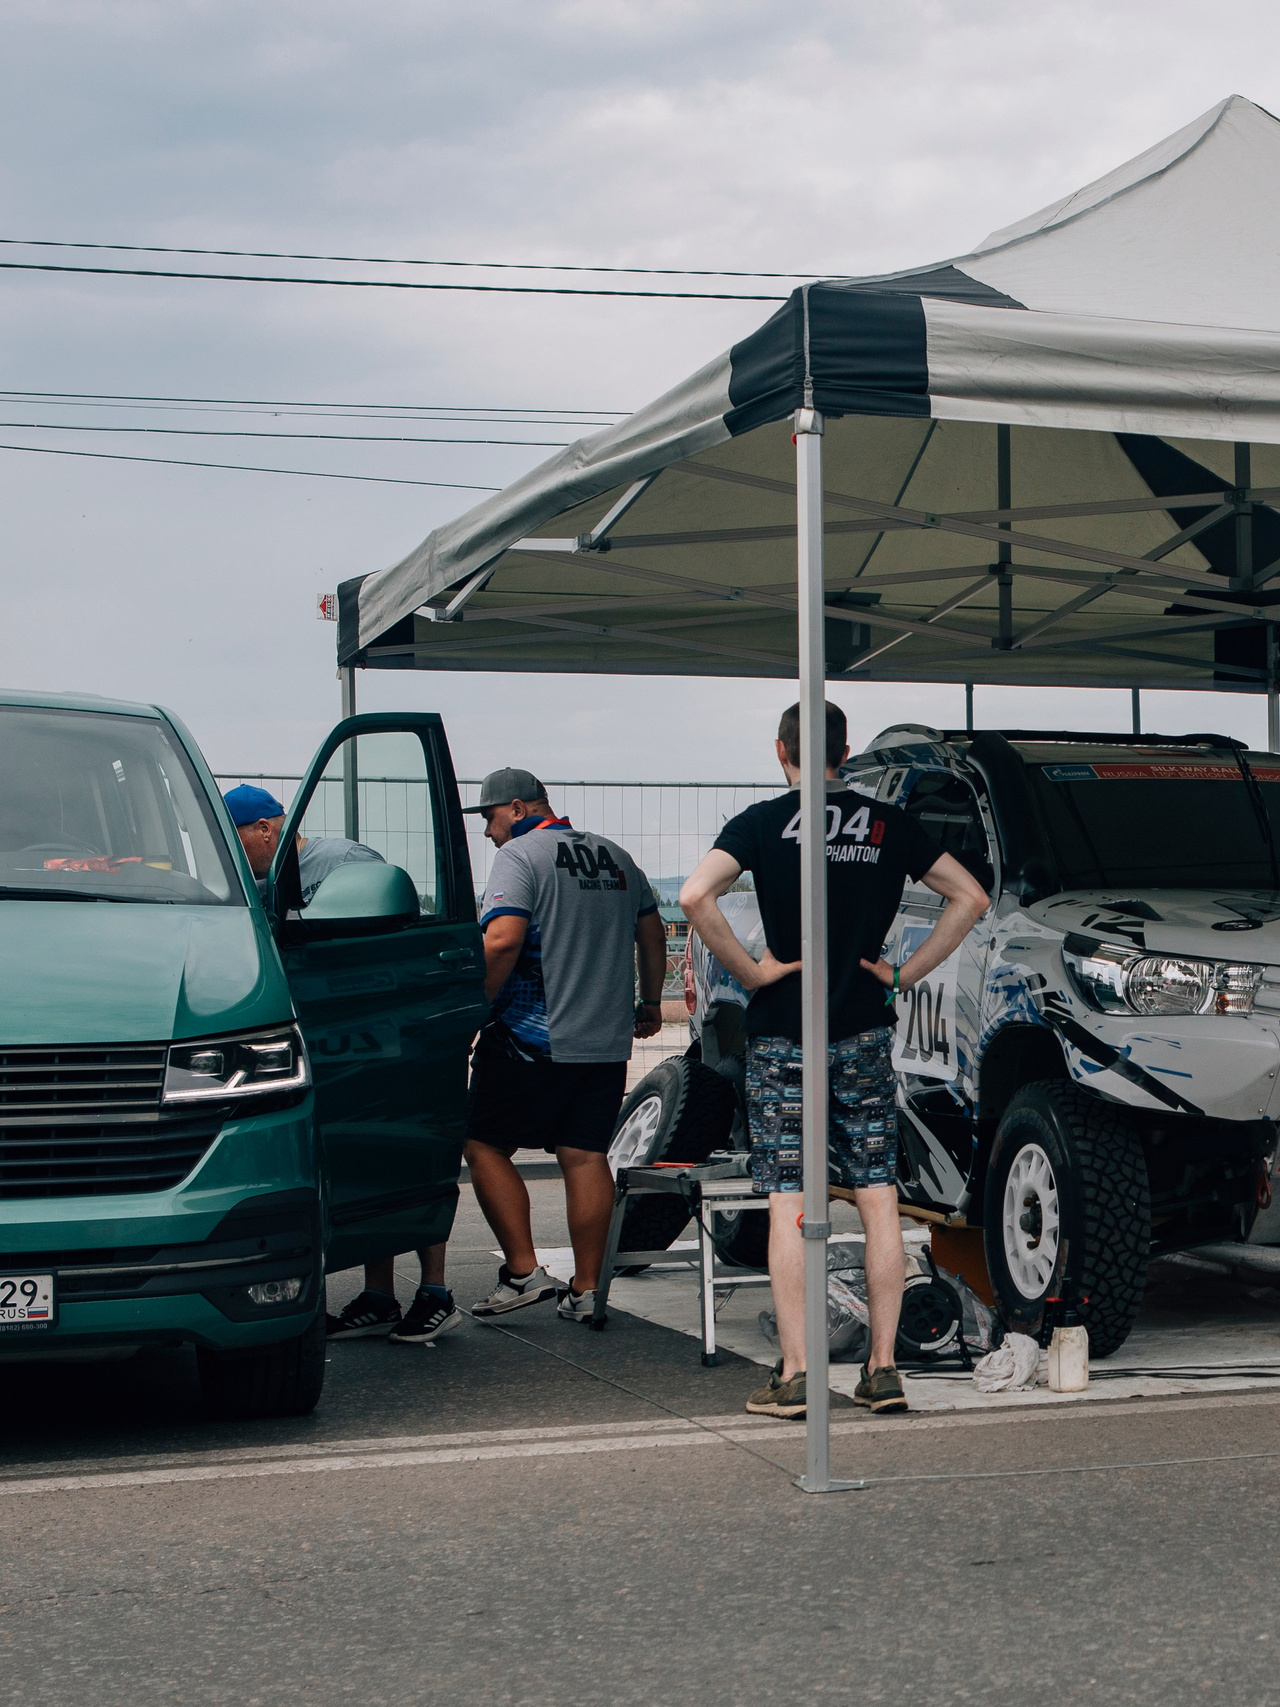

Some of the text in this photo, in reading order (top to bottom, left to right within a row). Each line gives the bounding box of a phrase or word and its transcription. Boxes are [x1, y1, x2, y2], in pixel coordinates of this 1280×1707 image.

[1179, 766, 1208, 774] WAY
[1210, 767, 1241, 775] RALL
[1179, 771, 1226, 779] EDITION
[556, 841, 619, 879] 404
[826, 844, 881, 864] PHANTOM
[579, 879, 602, 891] RACING
[603, 879, 620, 891] TEAM
[900, 980, 950, 1066] 204
[0, 1279, 38, 1308] 29
[0, 1308, 26, 1320] RUS
